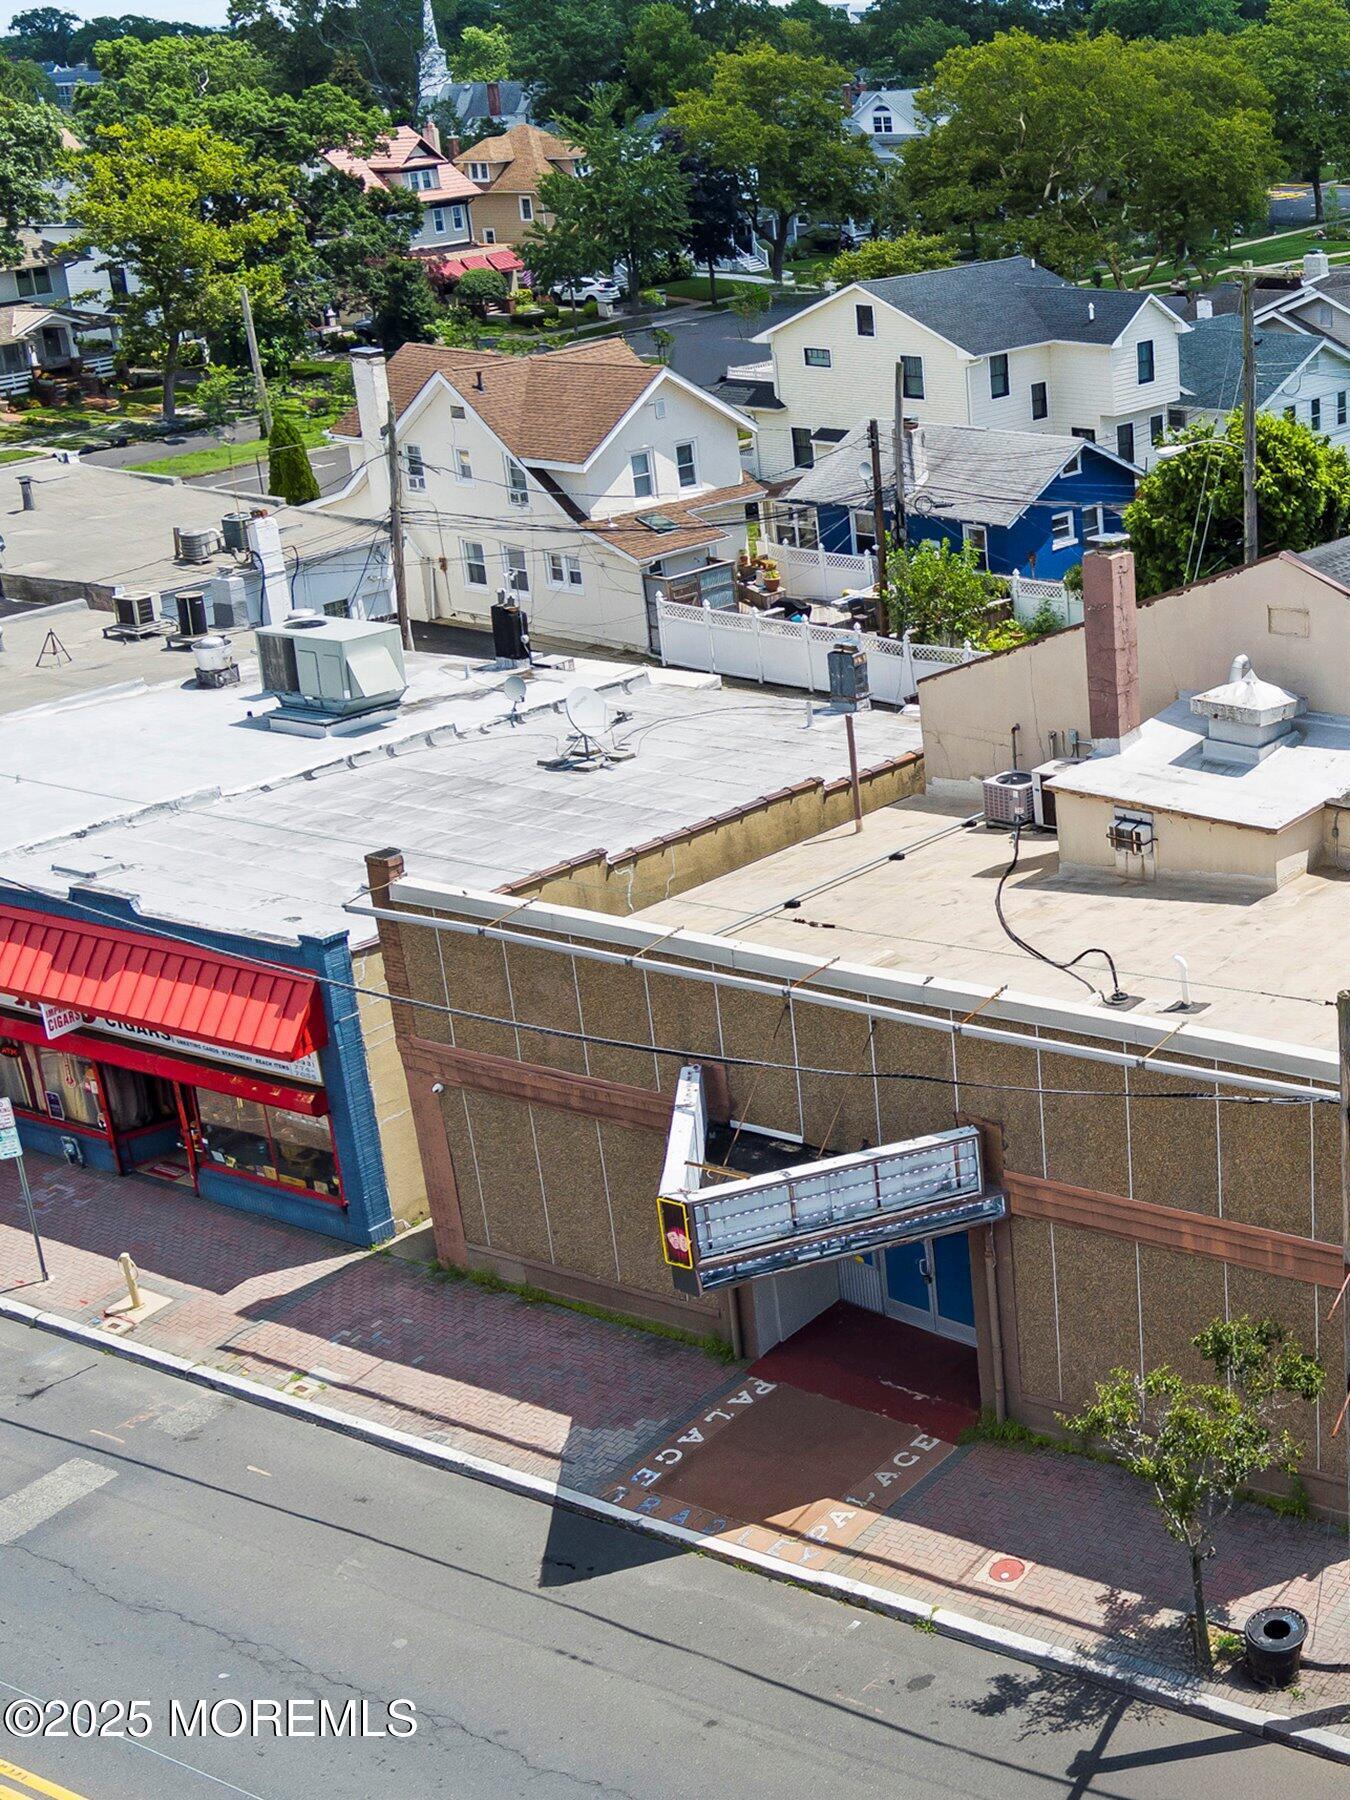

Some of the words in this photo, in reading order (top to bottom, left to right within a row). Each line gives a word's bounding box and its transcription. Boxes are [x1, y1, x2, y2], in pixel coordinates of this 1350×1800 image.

[48, 1011, 81, 1032] CIGARS
[630, 1375, 778, 1487] PALACE
[806, 1433, 941, 1544] PALACE
